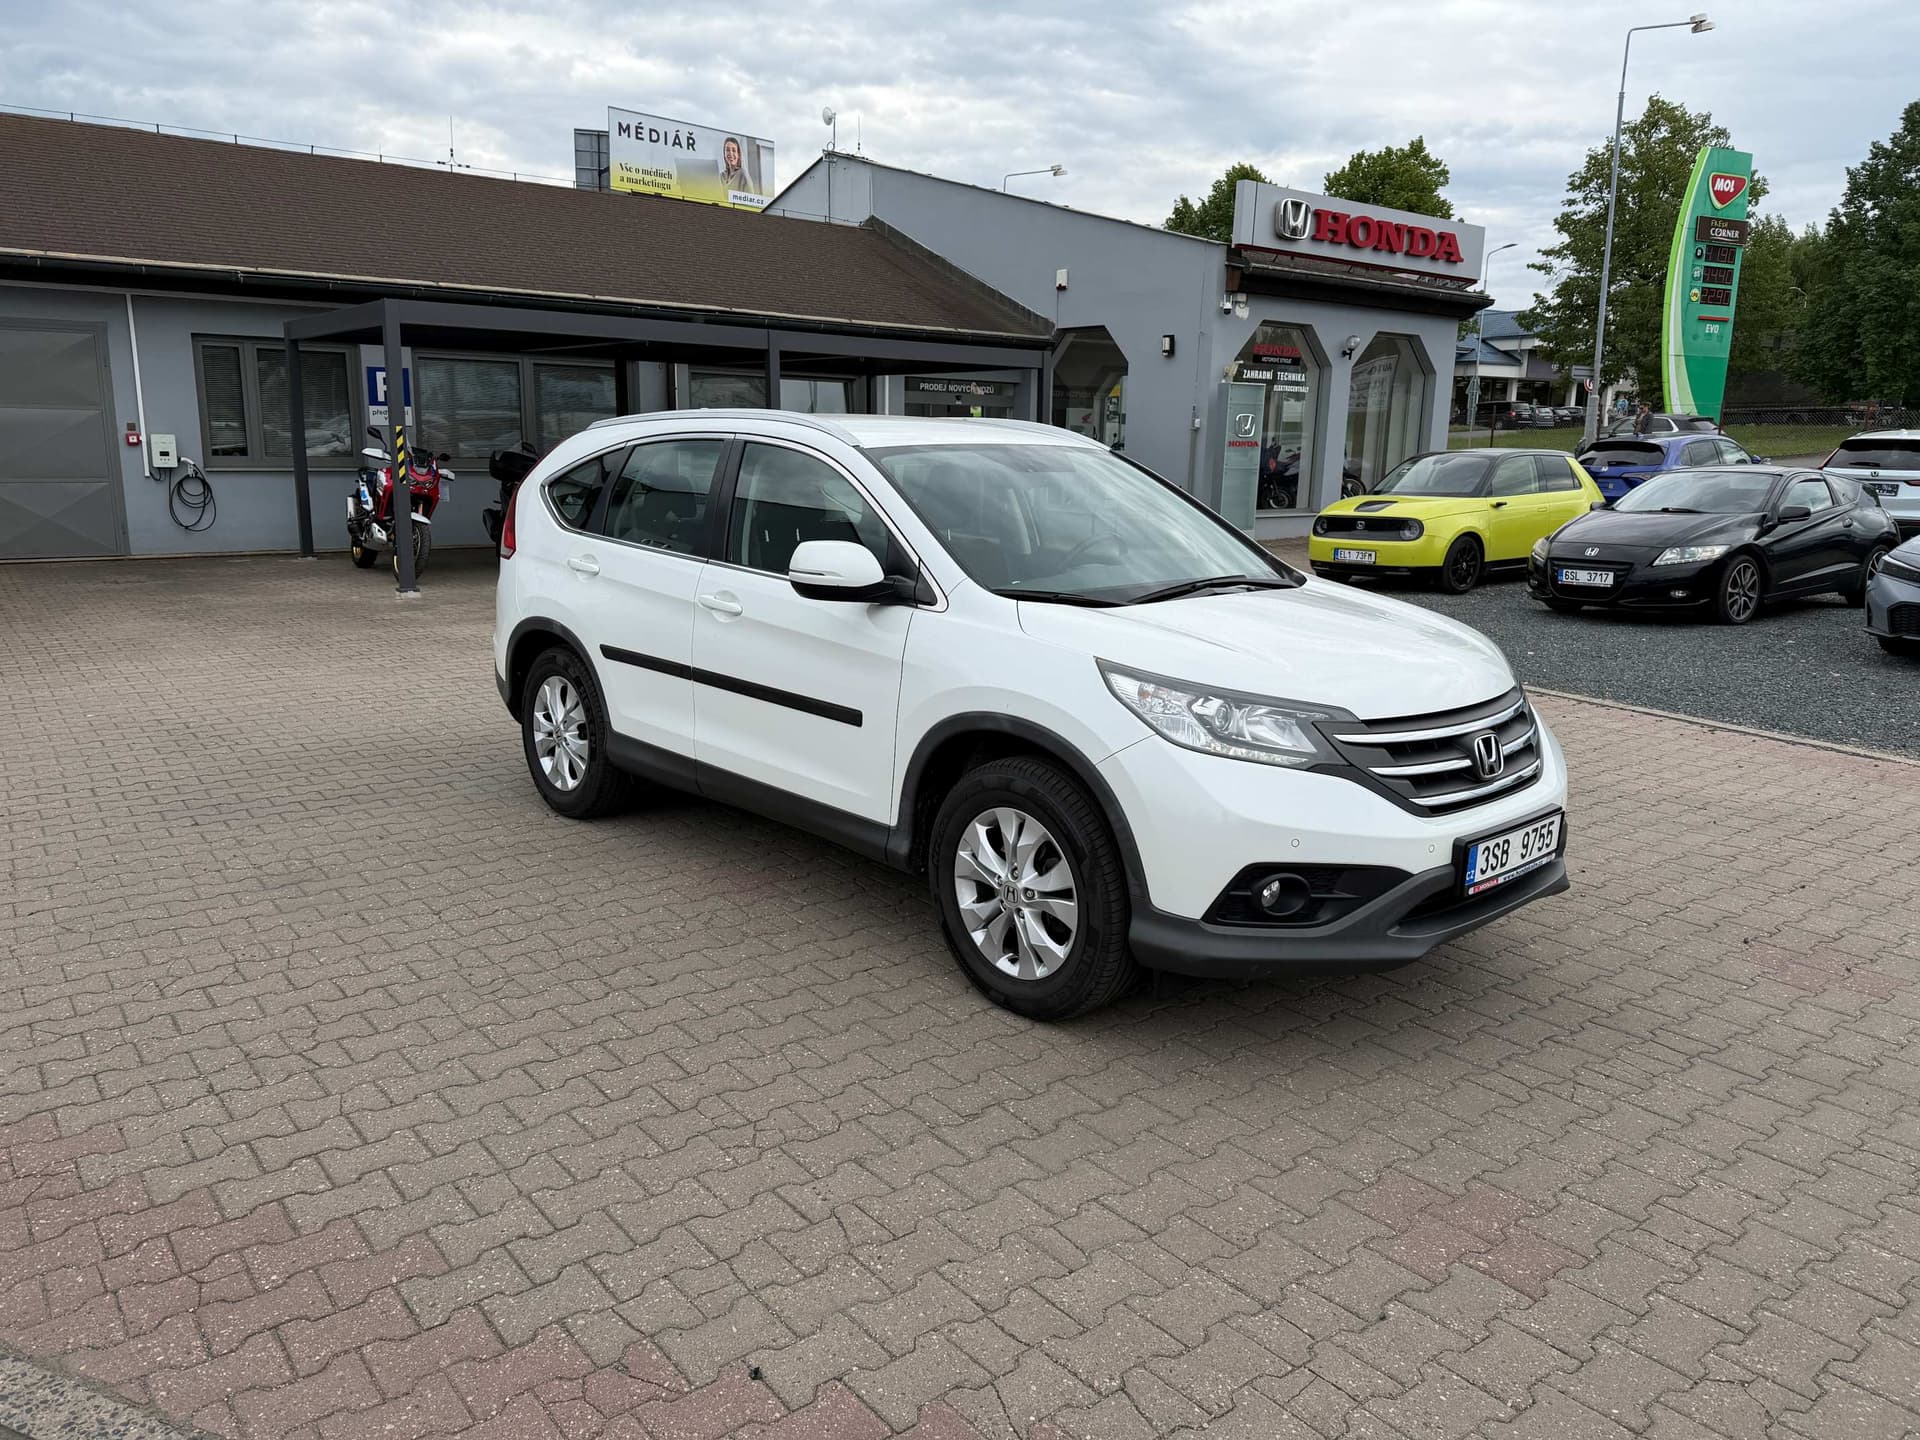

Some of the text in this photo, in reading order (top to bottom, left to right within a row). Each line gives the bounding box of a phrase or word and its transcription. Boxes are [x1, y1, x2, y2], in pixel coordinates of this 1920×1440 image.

[617, 121, 697, 151] MÉDIÁŘ
[619, 162, 634, 173] Vše
[641, 167, 673, 180] médiích
[619, 175, 672, 191] a marketingu
[1714, 178, 1735, 192] MOL
[732, 193, 765, 206] mediar.cz
[1312, 208, 1465, 264] HONDA
[1710, 227, 1740, 239] CORNER
[1705, 323, 1719, 334] EVO
[1253, 344, 1300, 356] HONDA
[1243, 369, 1306, 382] ZAHRADNÍ TECHNIKA
[919, 382, 947, 391] PRODEJ
[1356, 552, 1372, 560] 73FM
[1564, 571, 1609, 582] 6SL 3717
[1480, 838, 1511, 875] 3SB
[1520, 820, 1555, 860] 9755
[1466, 870, 1475, 880] CZ
